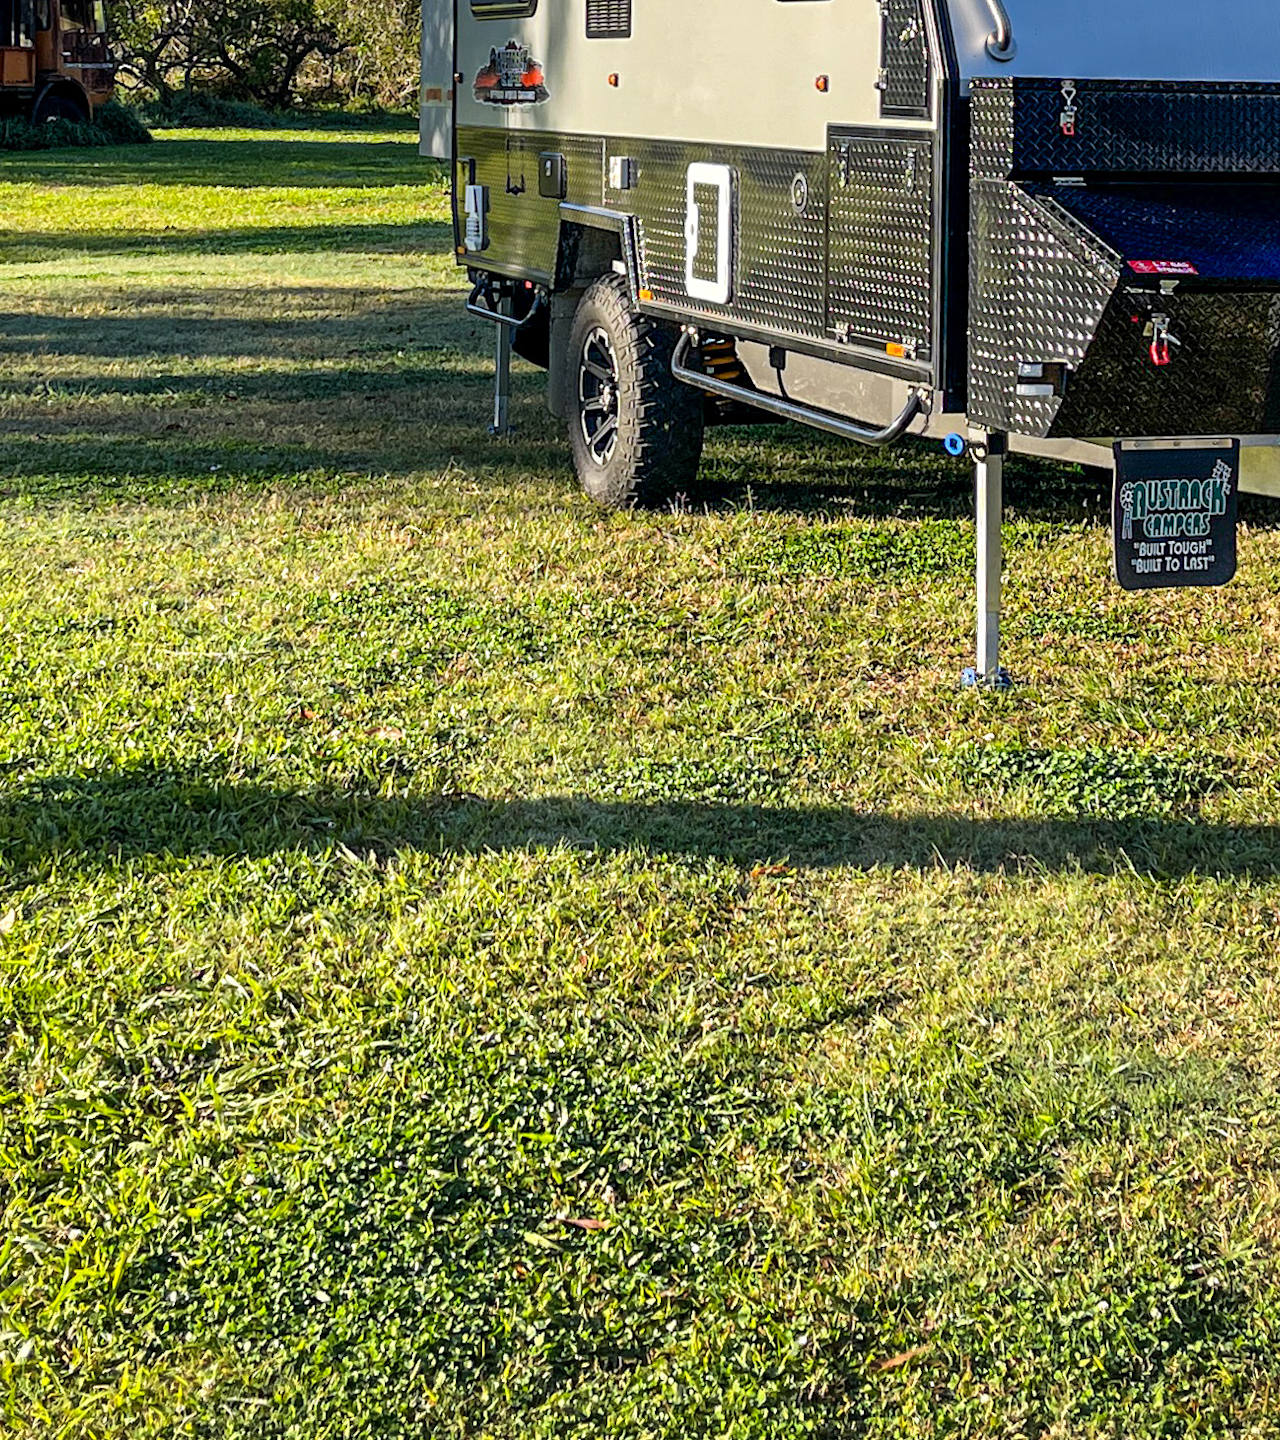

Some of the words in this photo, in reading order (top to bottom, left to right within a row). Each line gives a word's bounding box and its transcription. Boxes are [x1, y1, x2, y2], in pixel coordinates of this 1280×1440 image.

[1132, 479, 1226, 520] AUSTRACK
[1143, 512, 1211, 538] CAMPERS
[1165, 556, 1181, 572] TO
